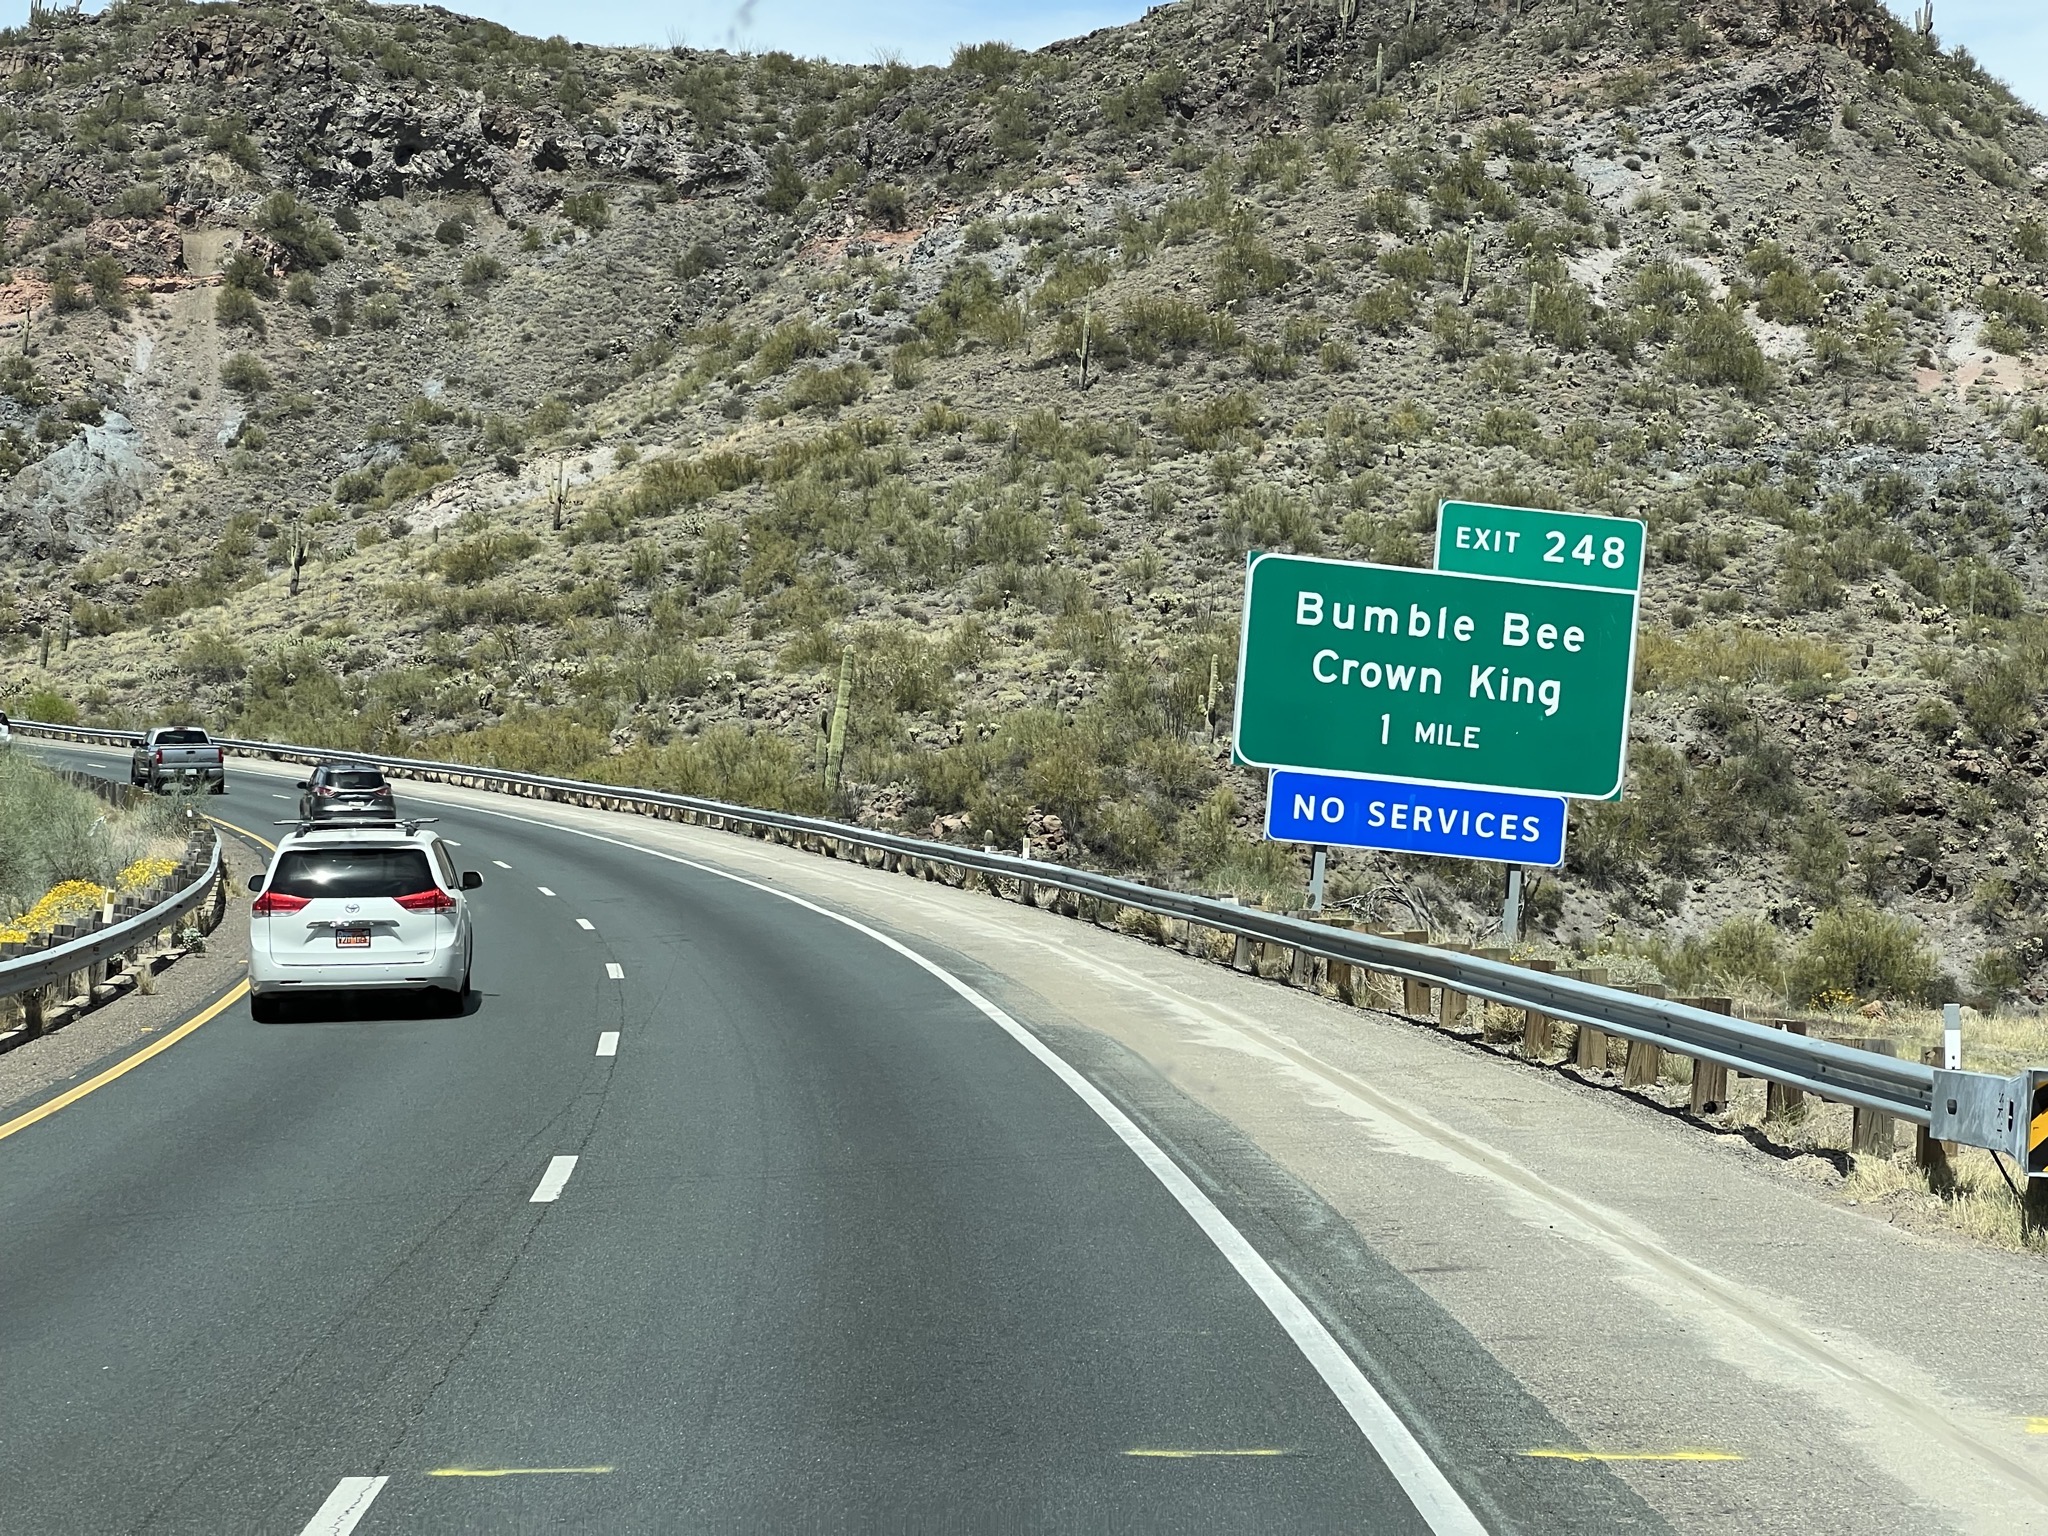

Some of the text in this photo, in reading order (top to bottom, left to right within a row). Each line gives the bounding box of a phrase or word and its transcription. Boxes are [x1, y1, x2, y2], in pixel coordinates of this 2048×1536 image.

[1456, 526, 1626, 570] EXIT 248
[1295, 591, 1586, 653] Bumble Bee
[1312, 649, 1562, 717] Crown King
[1380, 713, 1481, 749] 1 MILE
[1292, 793, 1541, 843] NO SERVICES
